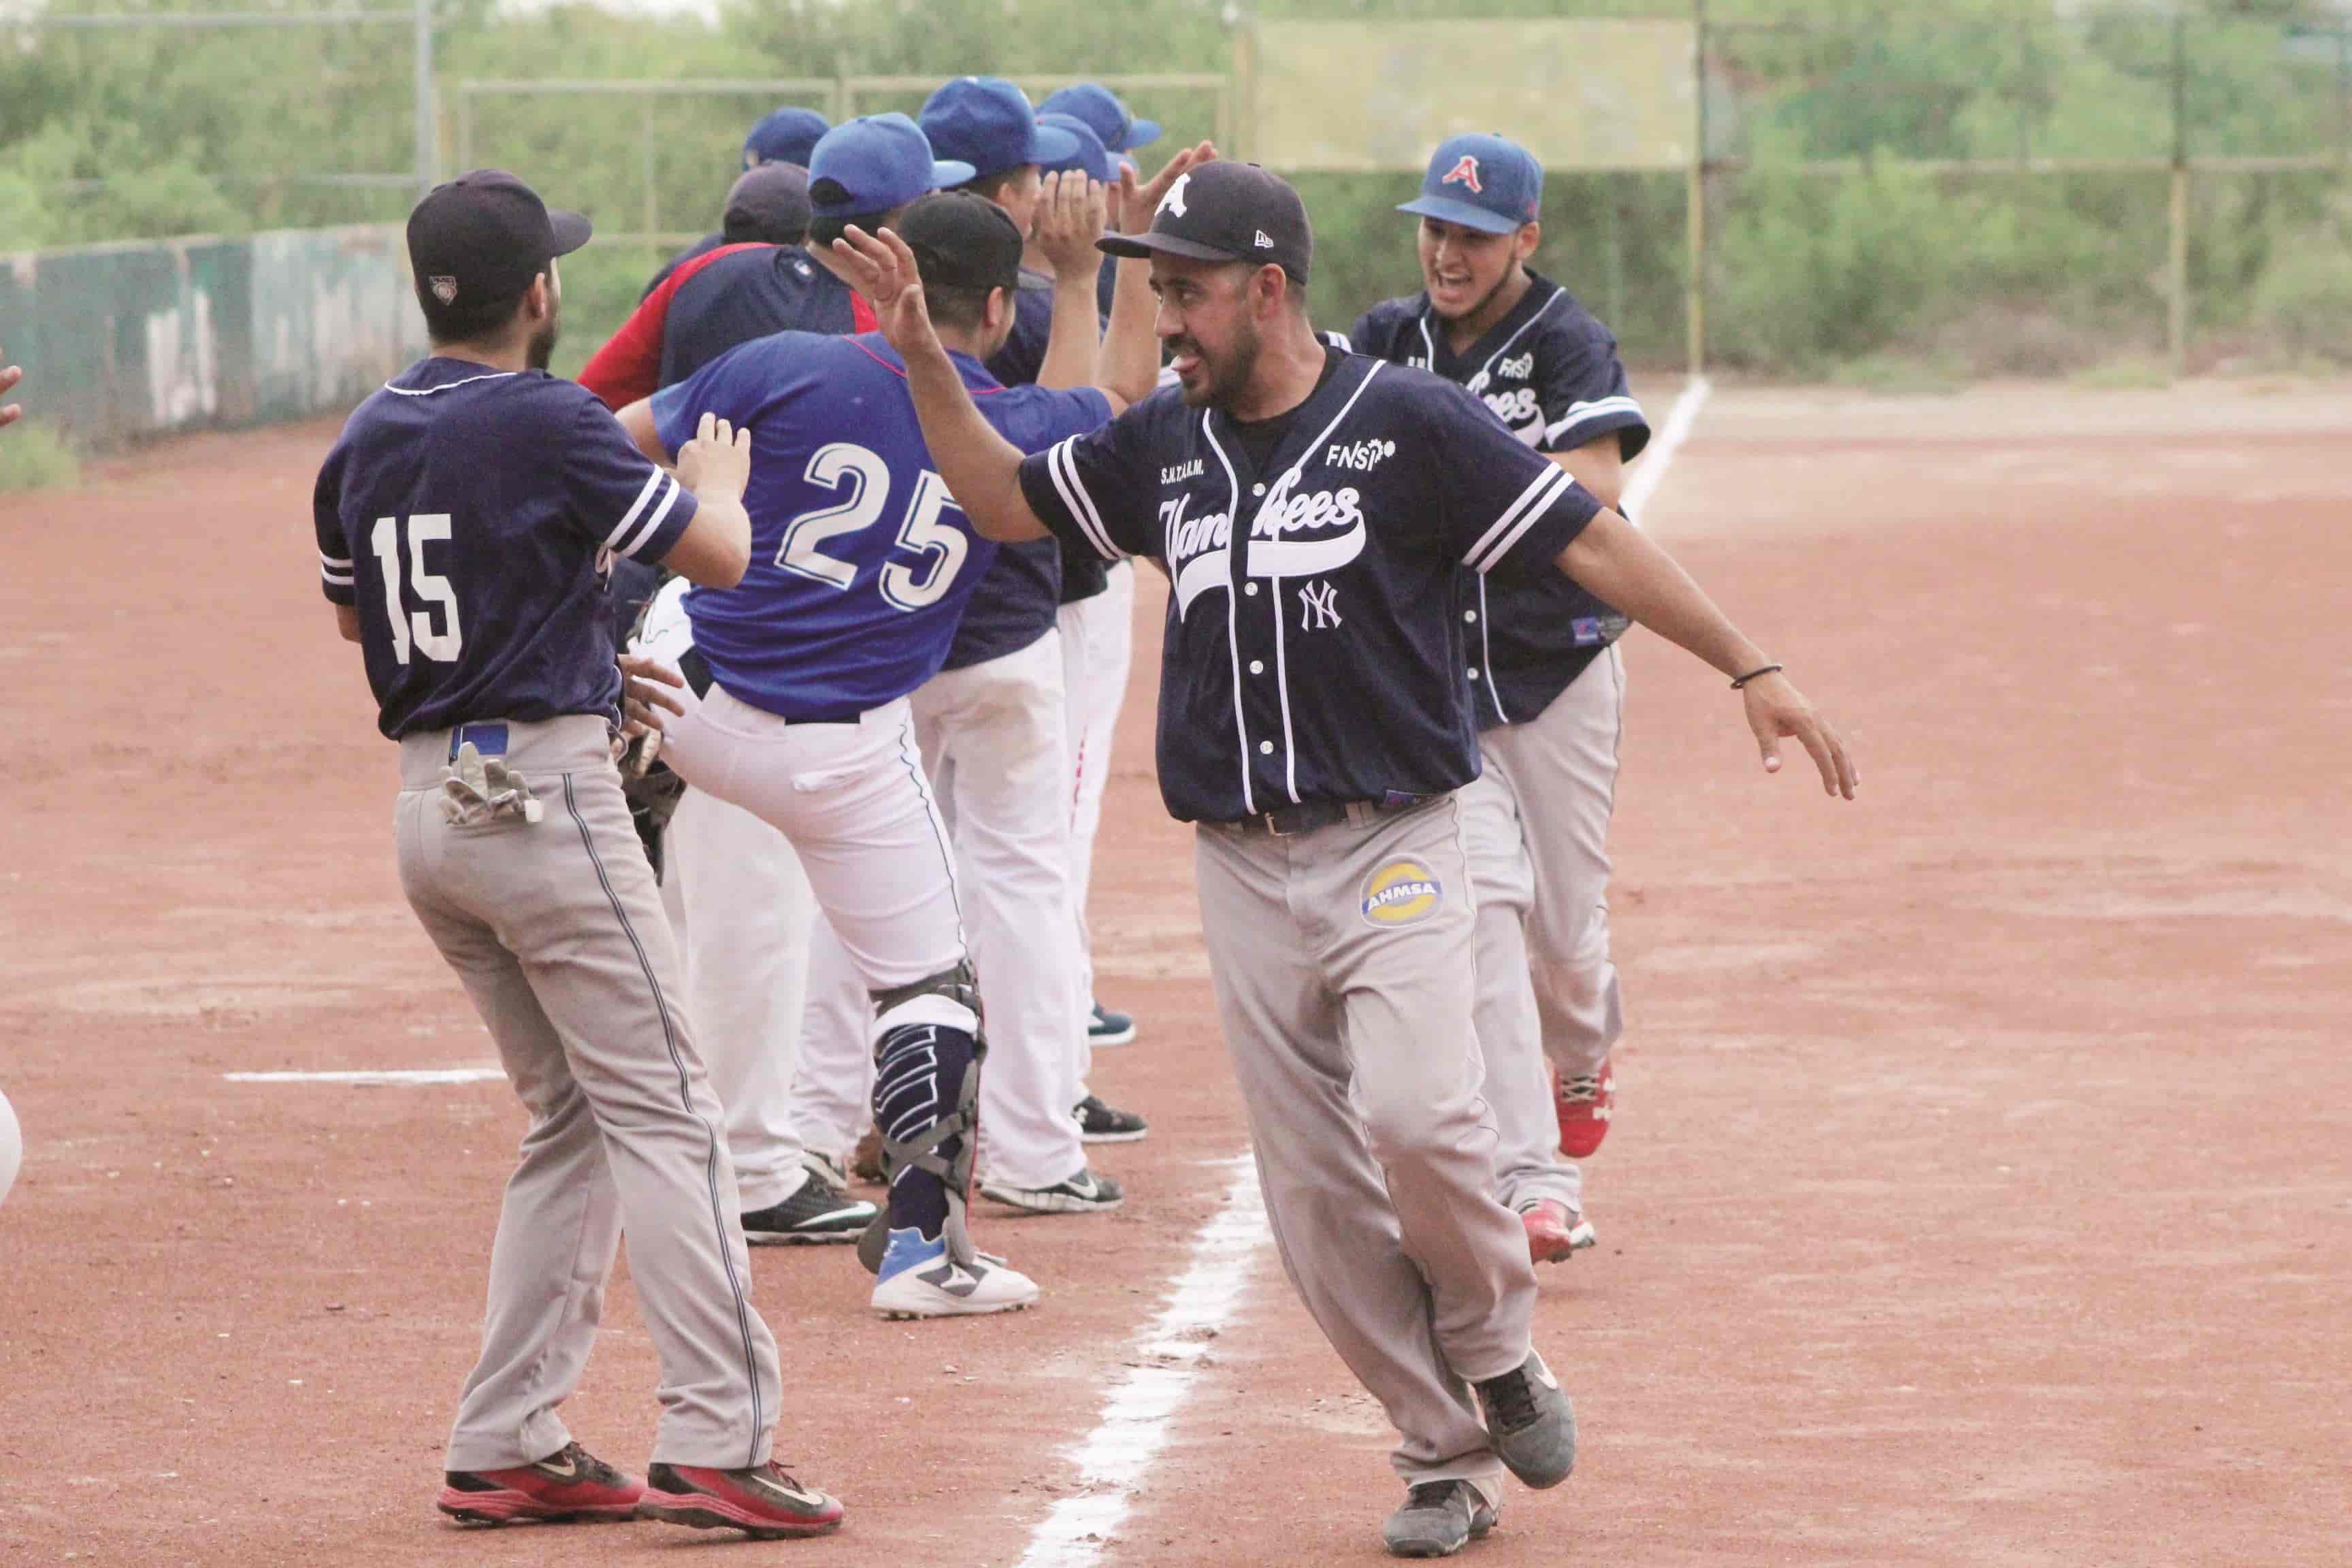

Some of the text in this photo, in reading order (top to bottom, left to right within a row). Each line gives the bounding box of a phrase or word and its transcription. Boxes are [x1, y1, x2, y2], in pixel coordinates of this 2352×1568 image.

[774, 442, 969, 612] 25
[371, 513, 463, 665] 15
[1298, 579, 1343, 632] NY
[1368, 883, 1437, 911] AHMSA
